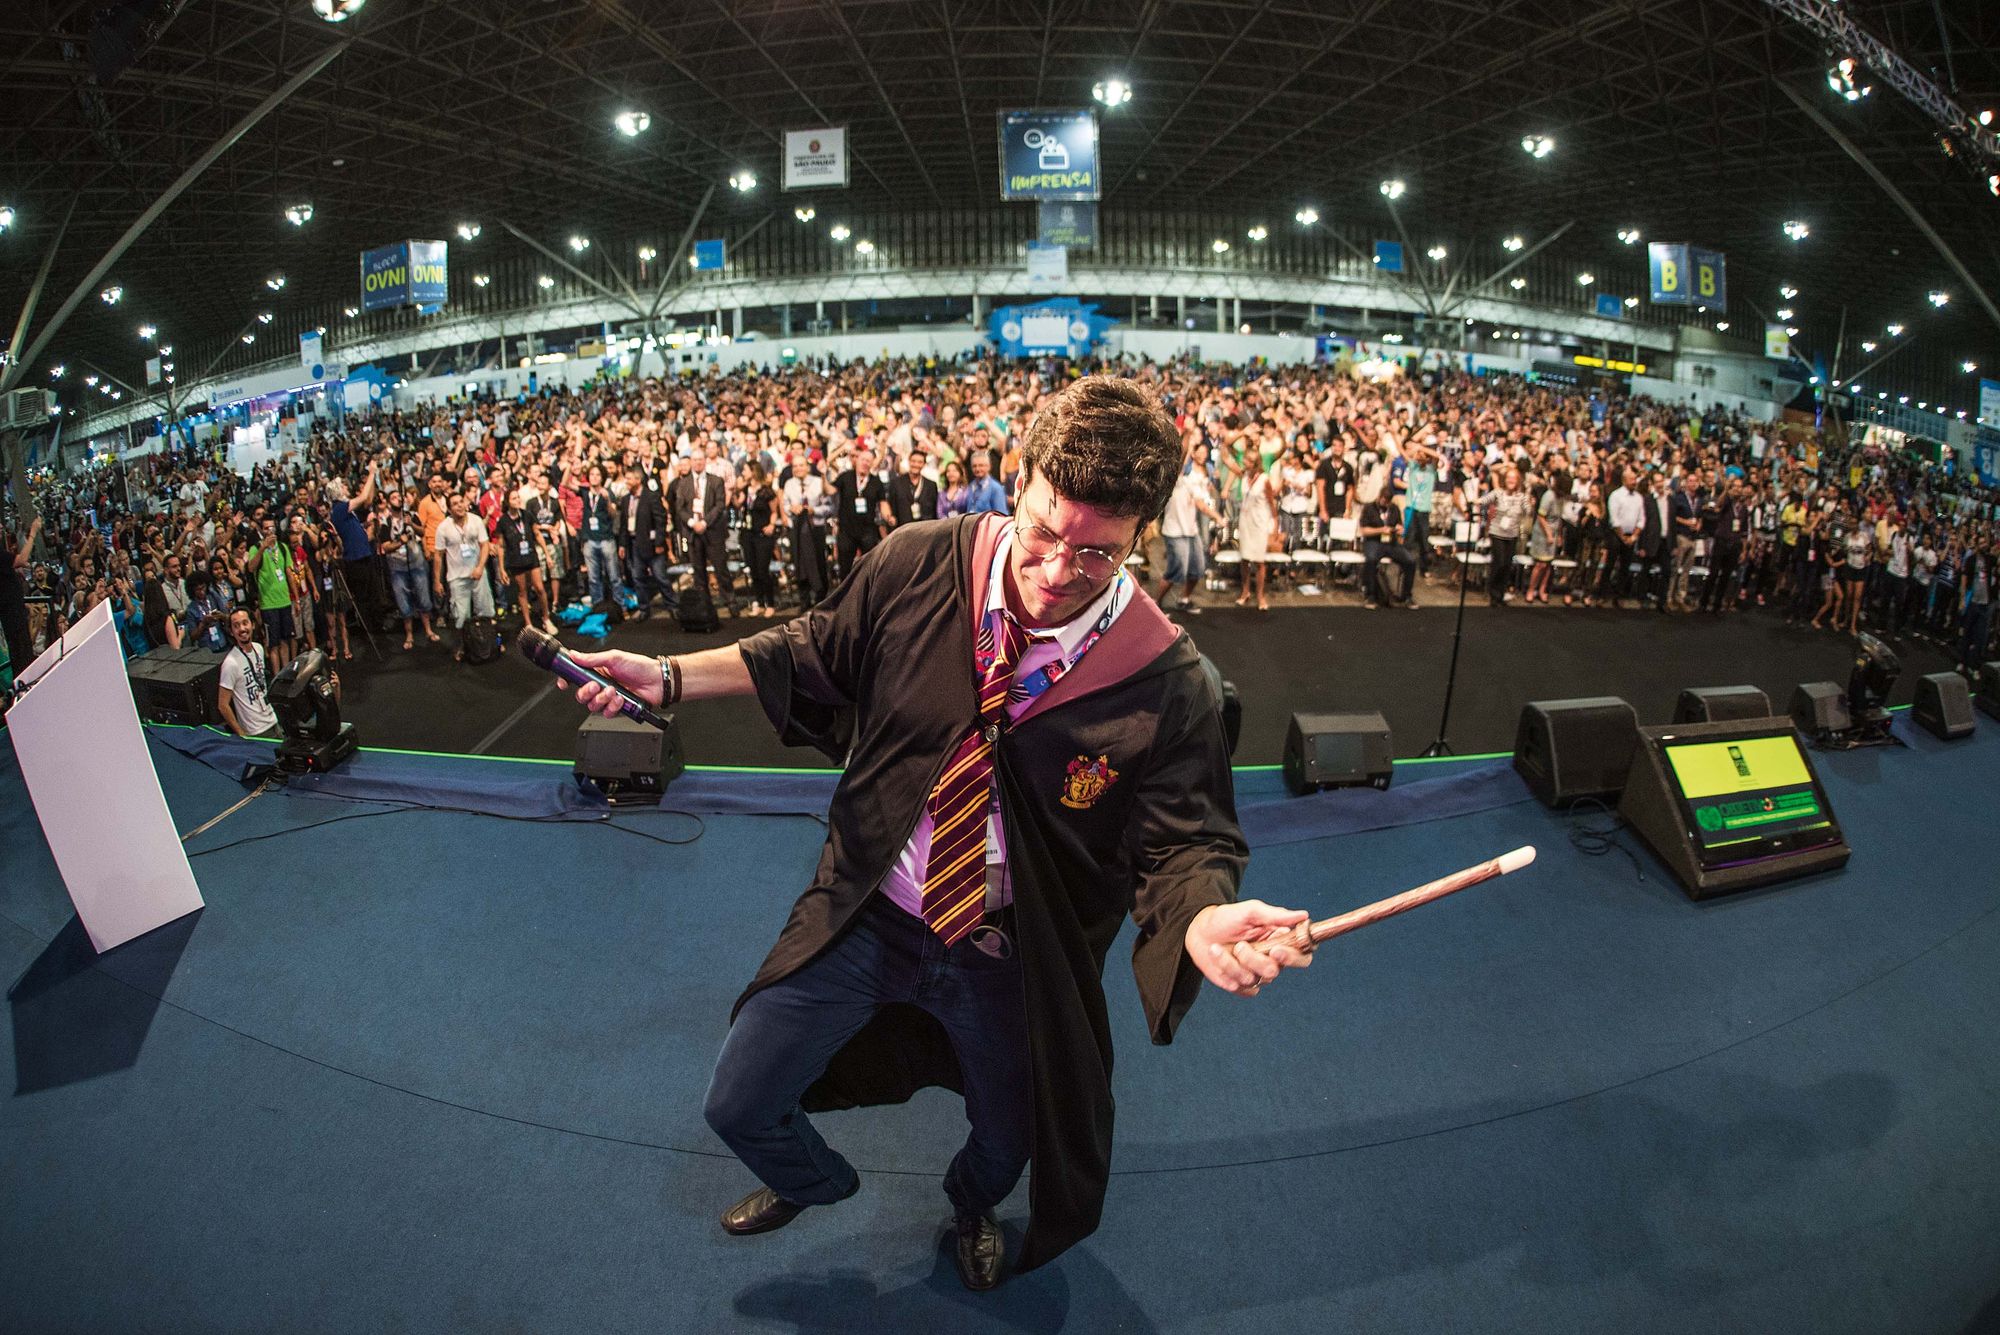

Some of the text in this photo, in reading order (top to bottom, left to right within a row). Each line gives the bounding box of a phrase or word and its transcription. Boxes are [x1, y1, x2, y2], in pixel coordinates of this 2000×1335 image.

[810, 159, 836, 167] PAULO
[1011, 171, 1092, 191] IMPRENSA
[366, 266, 406, 292] OVNI
[413, 265, 444, 284] OVNI
[1660, 260, 1678, 292] B
[1699, 265, 1716, 297] B
